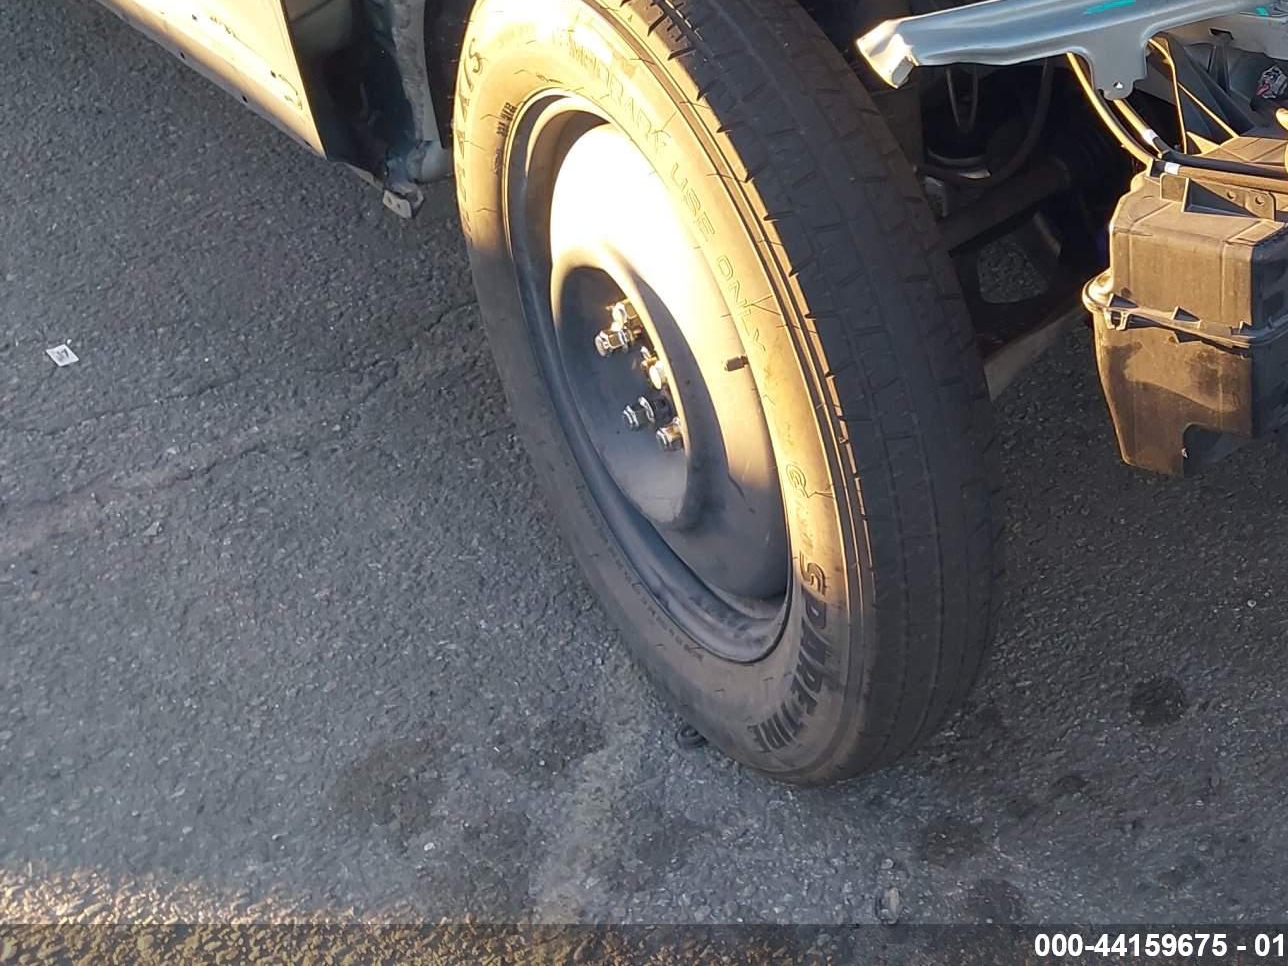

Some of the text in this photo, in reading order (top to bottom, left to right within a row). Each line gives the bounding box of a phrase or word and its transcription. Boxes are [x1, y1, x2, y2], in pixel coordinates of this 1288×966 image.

[670, 162, 716, 242] USE
[716, 255, 766, 352] ONLY
[789, 551, 828, 718] SPARE
[747, 700, 805, 754] TIRE
